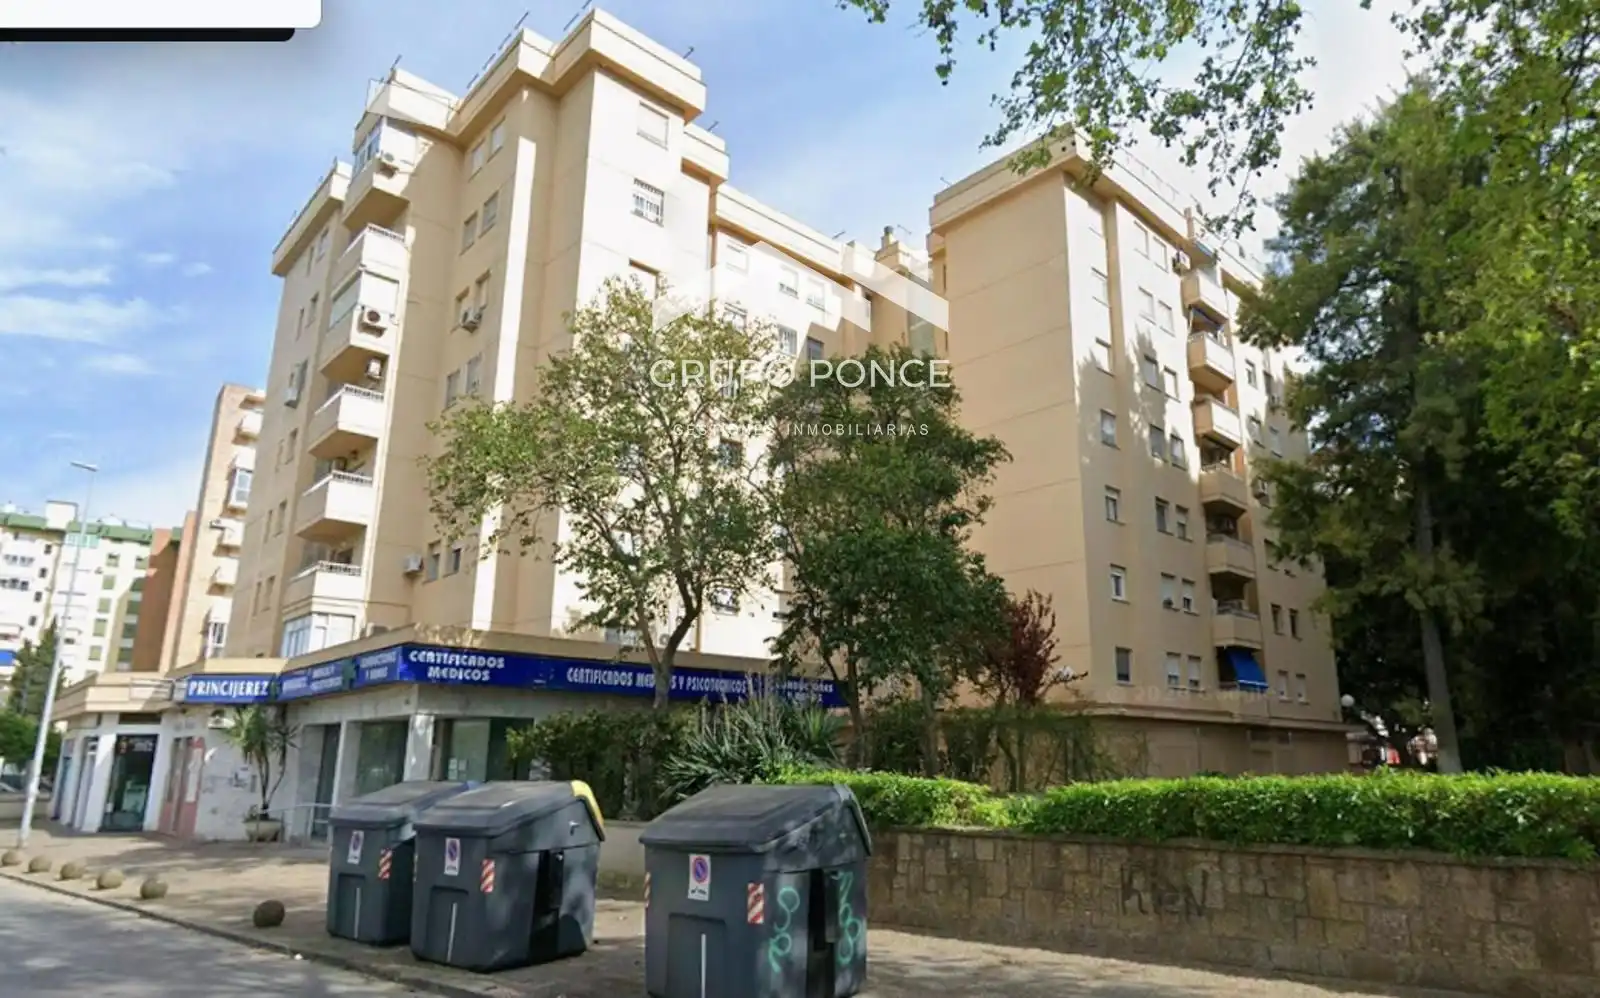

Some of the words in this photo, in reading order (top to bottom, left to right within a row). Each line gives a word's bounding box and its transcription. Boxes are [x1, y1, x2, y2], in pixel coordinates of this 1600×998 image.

[409, 650, 505, 669] CERTIFICADOS
[427, 666, 490, 681] MEDICOS
[566, 667, 633, 687] CERTIFICADOS
[635, 671, 677, 690] MEDS
[678, 675, 685, 690] Y
[188, 680, 269, 698] PRINCIJEREZ
